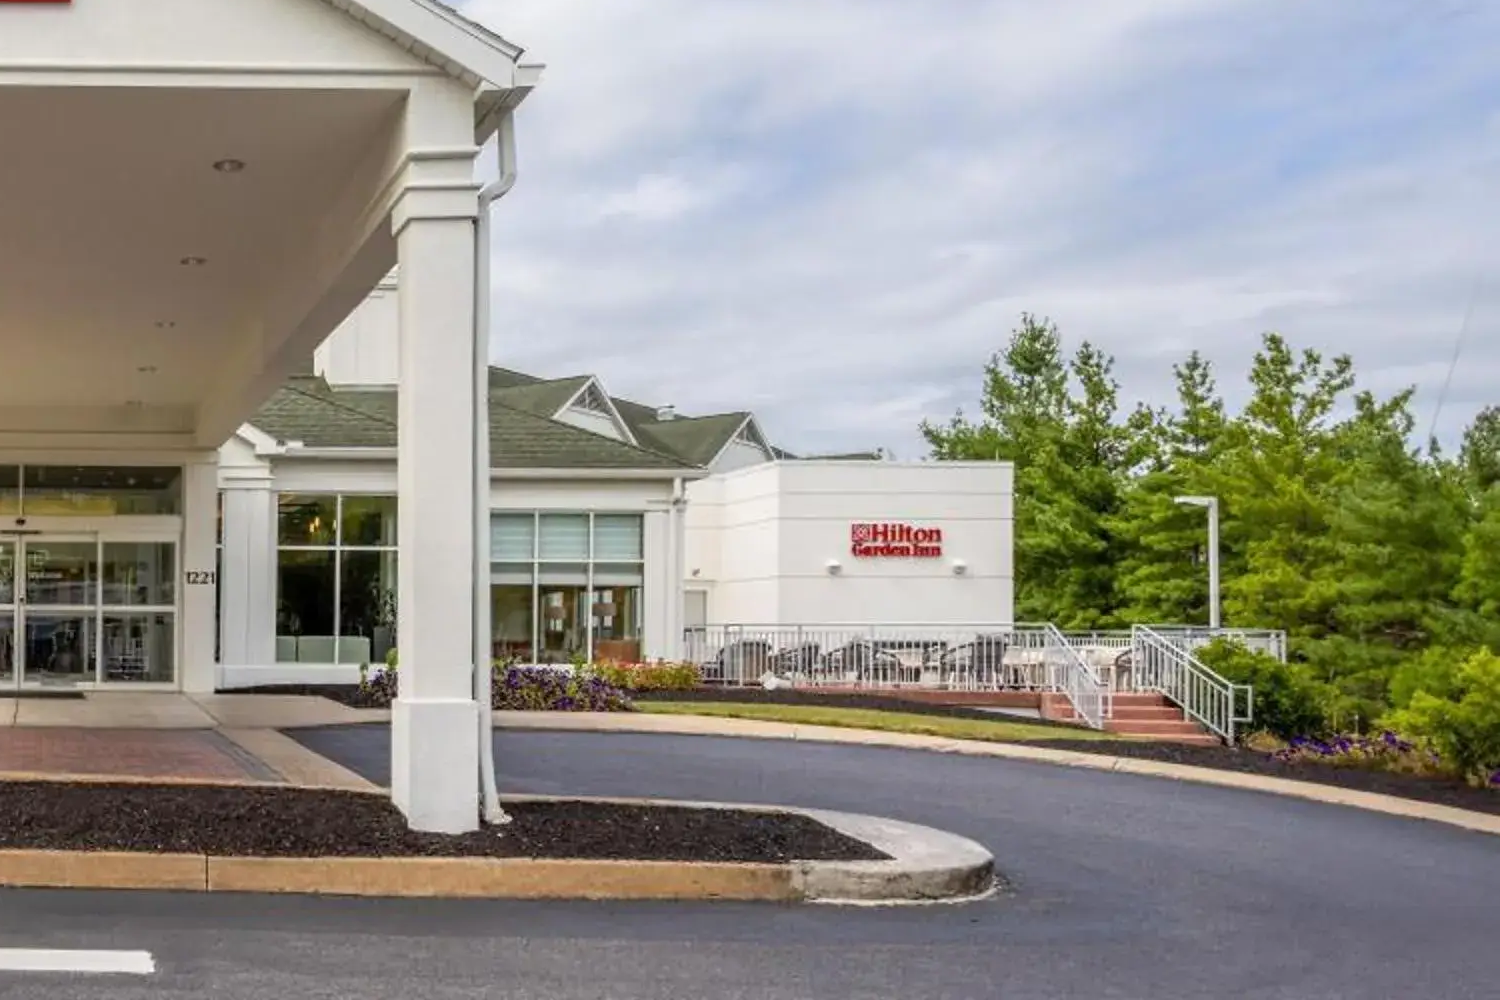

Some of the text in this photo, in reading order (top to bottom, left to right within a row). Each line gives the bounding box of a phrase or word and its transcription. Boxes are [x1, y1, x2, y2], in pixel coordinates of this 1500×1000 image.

[871, 523, 942, 542] Hilton
[851, 542, 942, 557] Garden Inn
[187, 571, 215, 585] 1221
